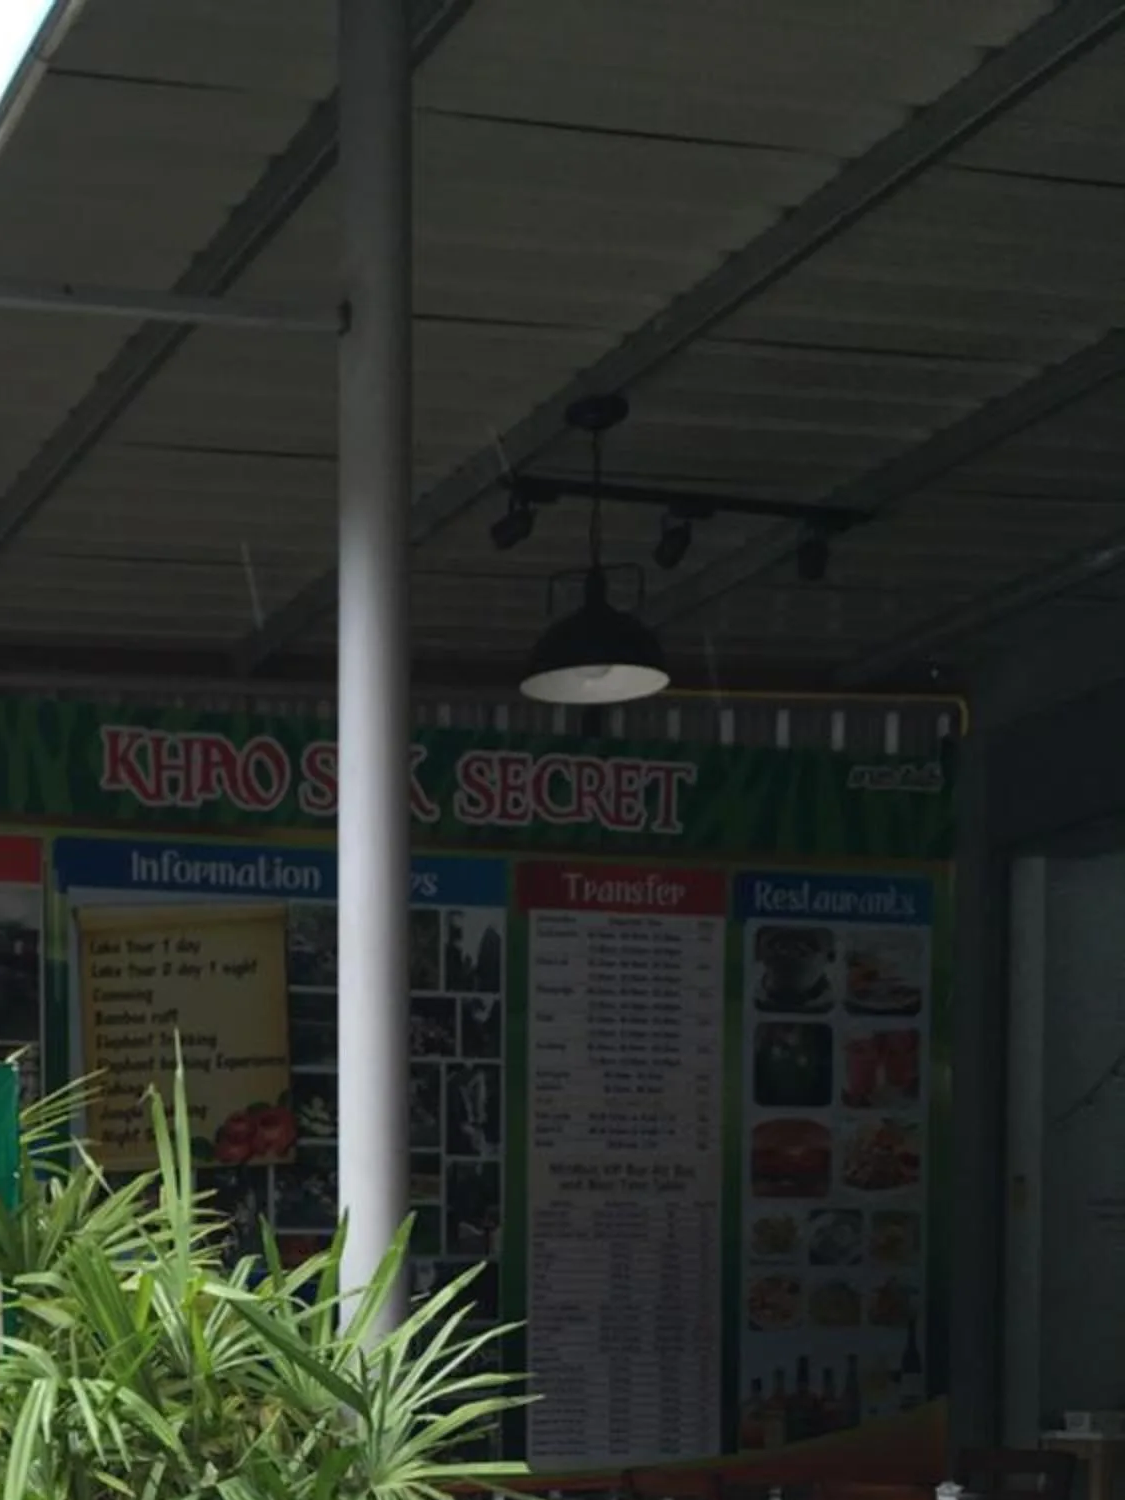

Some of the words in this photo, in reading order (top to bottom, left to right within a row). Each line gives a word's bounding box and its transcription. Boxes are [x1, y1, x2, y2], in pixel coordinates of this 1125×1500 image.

[99, 724, 292, 814] KHAO
[453, 749, 696, 835] SECRET
[131, 850, 322, 892] Information
[561, 871, 686, 906] Transfer
[754, 879, 916, 916] Restaurants
